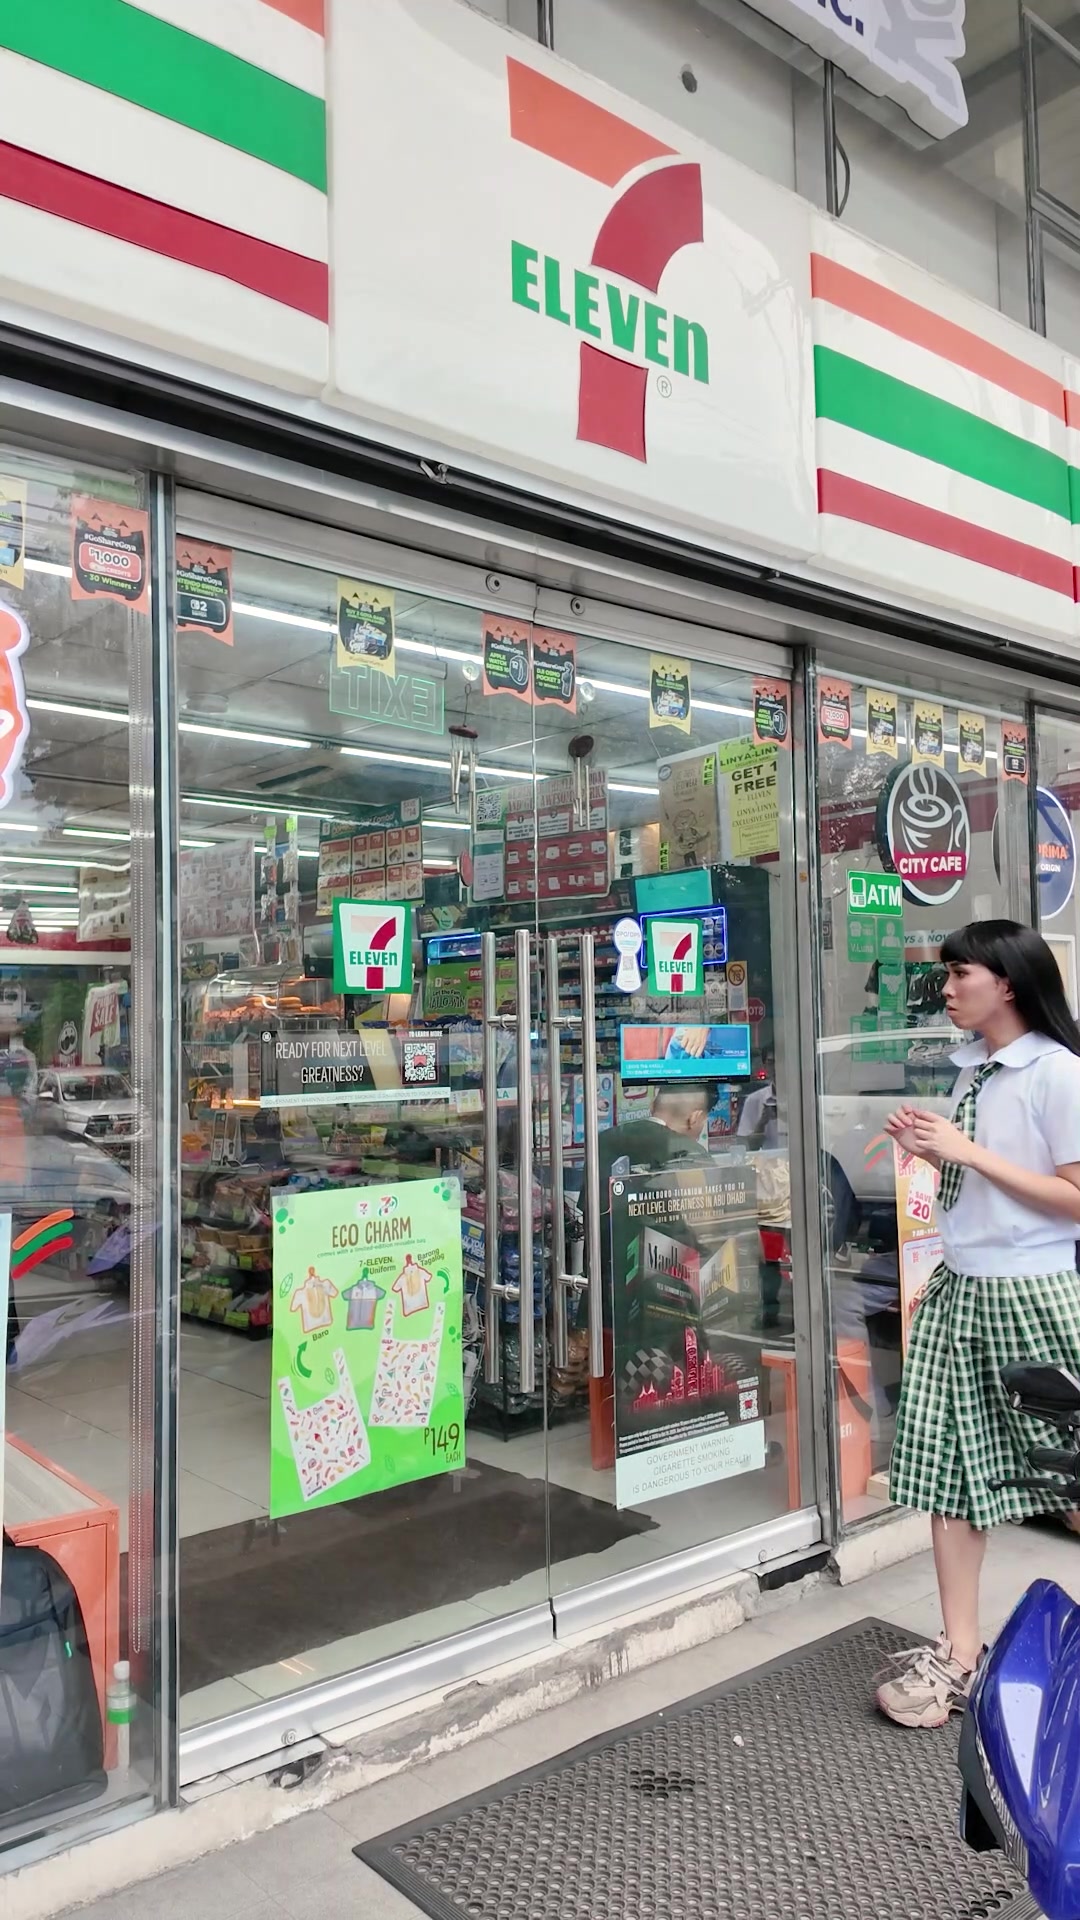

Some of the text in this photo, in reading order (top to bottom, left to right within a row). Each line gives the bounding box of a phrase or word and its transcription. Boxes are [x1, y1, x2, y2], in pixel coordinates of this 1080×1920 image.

[89, 574, 132, 590] 30 Winners
[720, 745, 779, 767] LINYA-LINY
[731, 764, 764, 782] GET
[769, 760, 778, 772] 1
[734, 775, 777, 795] FREE
[900, 855, 962, 874] CITY CAFE
[1040, 864, 1061, 873] ORIGIN
[867, 884, 901, 907] ATM
[94, 1004, 115, 1028] SALE
[275, 1039, 388, 1059] READY FOR NEXT LEVEL
[301, 1064, 364, 1084] GREATNESS?
[898, 1160, 917, 1176] BITE
[638, 1189, 672, 1201] MARLBORO
[674, 1187, 703, 1196] TITANIUM
[705, 1184, 721, 1193] TAKES
[725, 1183, 736, 1191] YOU
[915, 1191, 932, 1204] SAVE
[628, 1191, 746, 1217] NEXT LEVEL GREATNESS IN ABU DHABI
[332, 1216, 412, 1248] ECO CHARM
[417, 1248, 440, 1261] Barong
[421, 1252, 445, 1267] Tagalog
[369, 1264, 397, 1275] Uniform
[312, 1329, 330, 1342] Baro
[445, 1452, 461, 1464] EACH
[646, 1434, 734, 1466] GOVERNMENT WARNING
[653, 1447, 731, 1476] CIGARETTE SMOKING
[632, 1484, 640, 1495] IS
[641, 1470, 690, 1492] DANGEROUS
[692, 1467, 702, 1478] TO
[703, 1460, 723, 1474] YOUR
